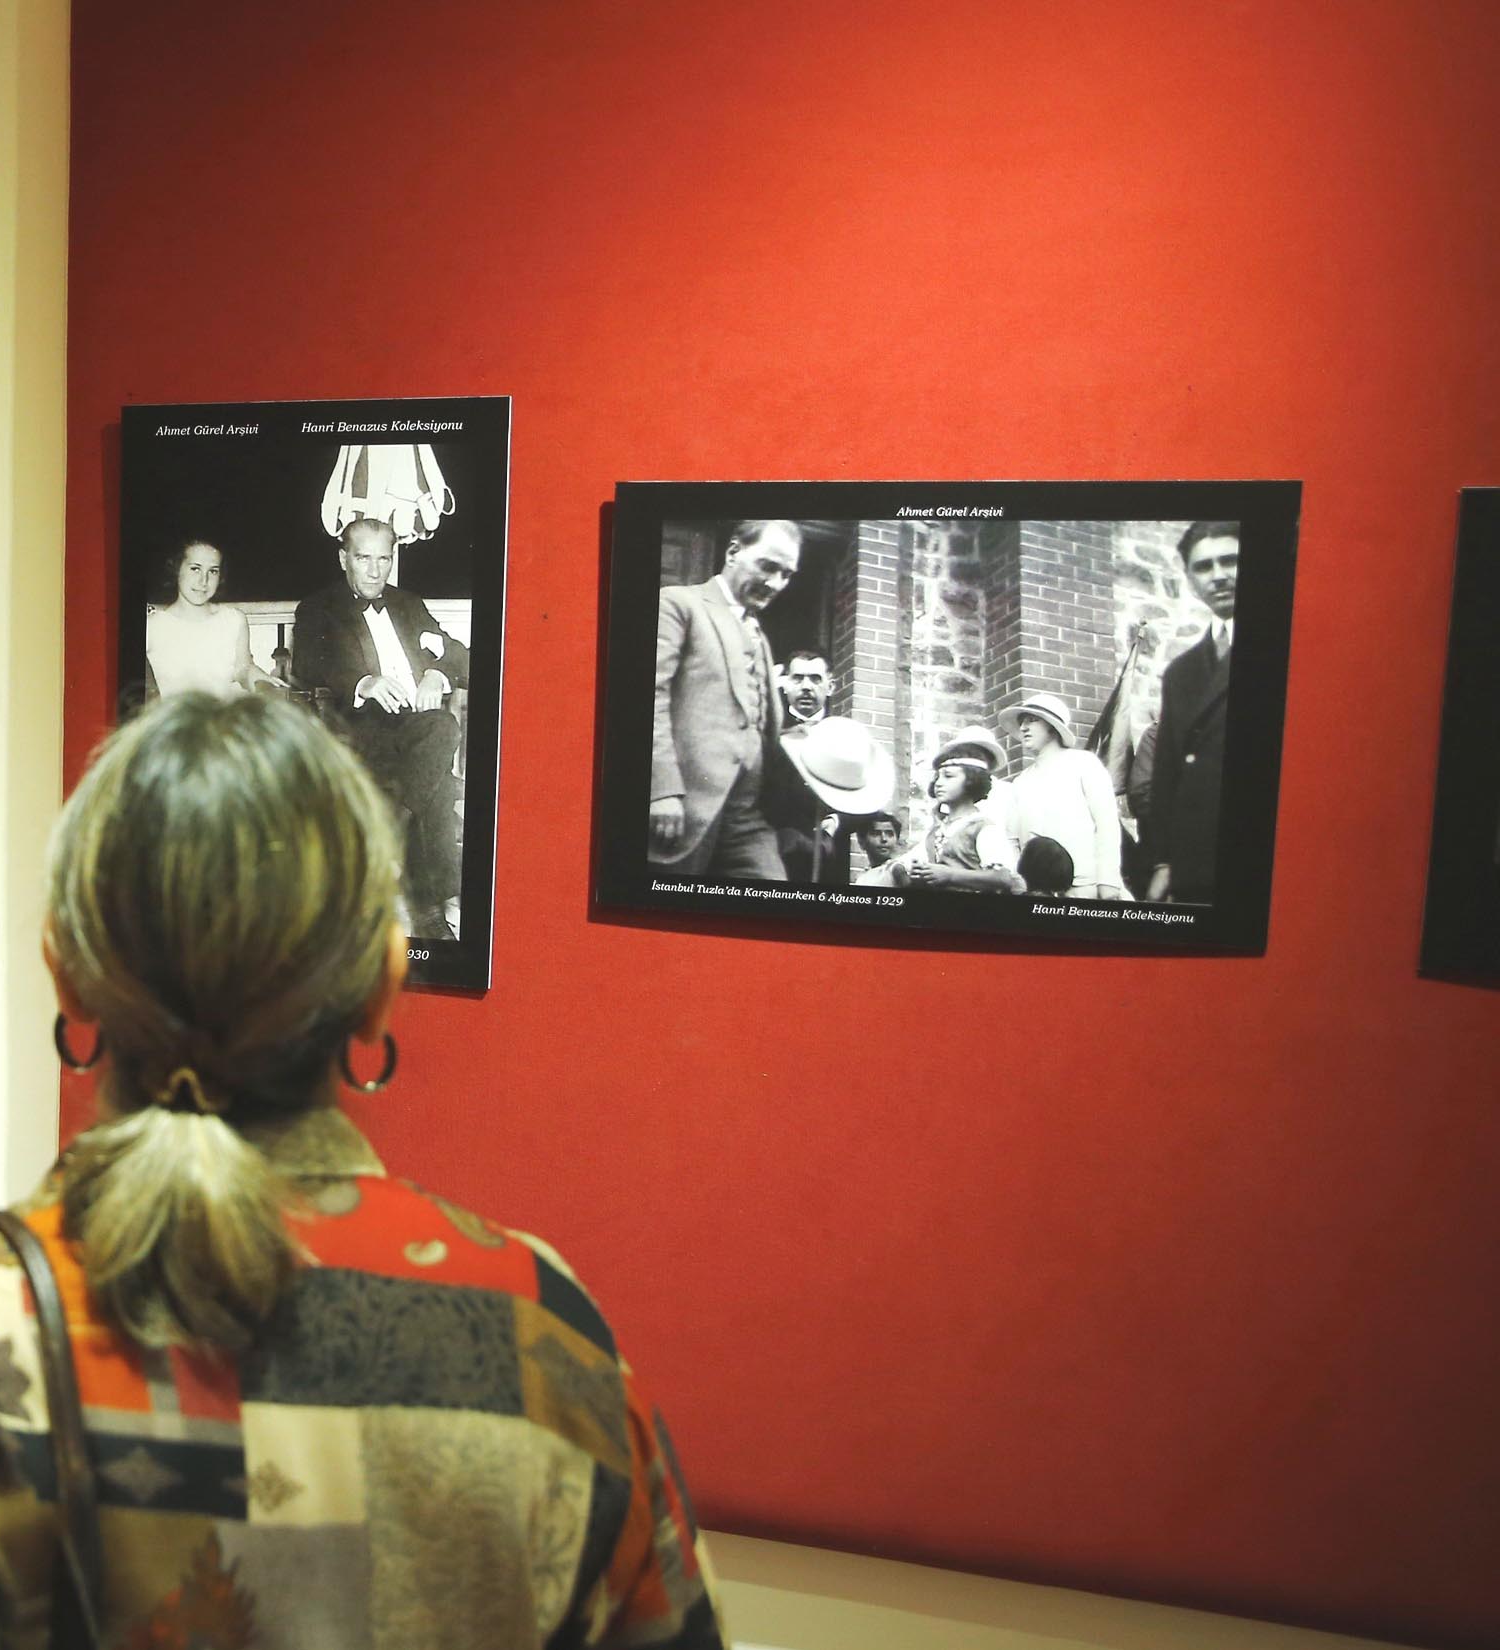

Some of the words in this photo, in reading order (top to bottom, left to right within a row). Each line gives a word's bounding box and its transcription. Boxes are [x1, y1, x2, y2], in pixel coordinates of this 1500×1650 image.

[156, 425, 191, 436] Ahmet
[193, 424, 224, 436] Gürel
[226, 423, 259, 437] Arşivi
[301, 421, 335, 433] Hanri
[337, 421, 388, 433] Benazus
[390, 419, 464, 434] Koleksiyonu
[896, 506, 934, 517] Ahmet
[936, 506, 968, 517] Gürel
[969, 506, 1004, 518] Arşivi
[651, 880, 694, 893] İstanbul
[743, 887, 815, 901] Karşılanırken
[818, 892, 826, 902] 6
[827, 893, 872, 905] Ağustos
[875, 896, 904, 906] 1929
[1032, 904, 1066, 915] Hanri
[1067, 906, 1119, 918] Benazus
[1121, 909, 1195, 924] Koleksiyonu
[406, 948, 430, 961] 930
